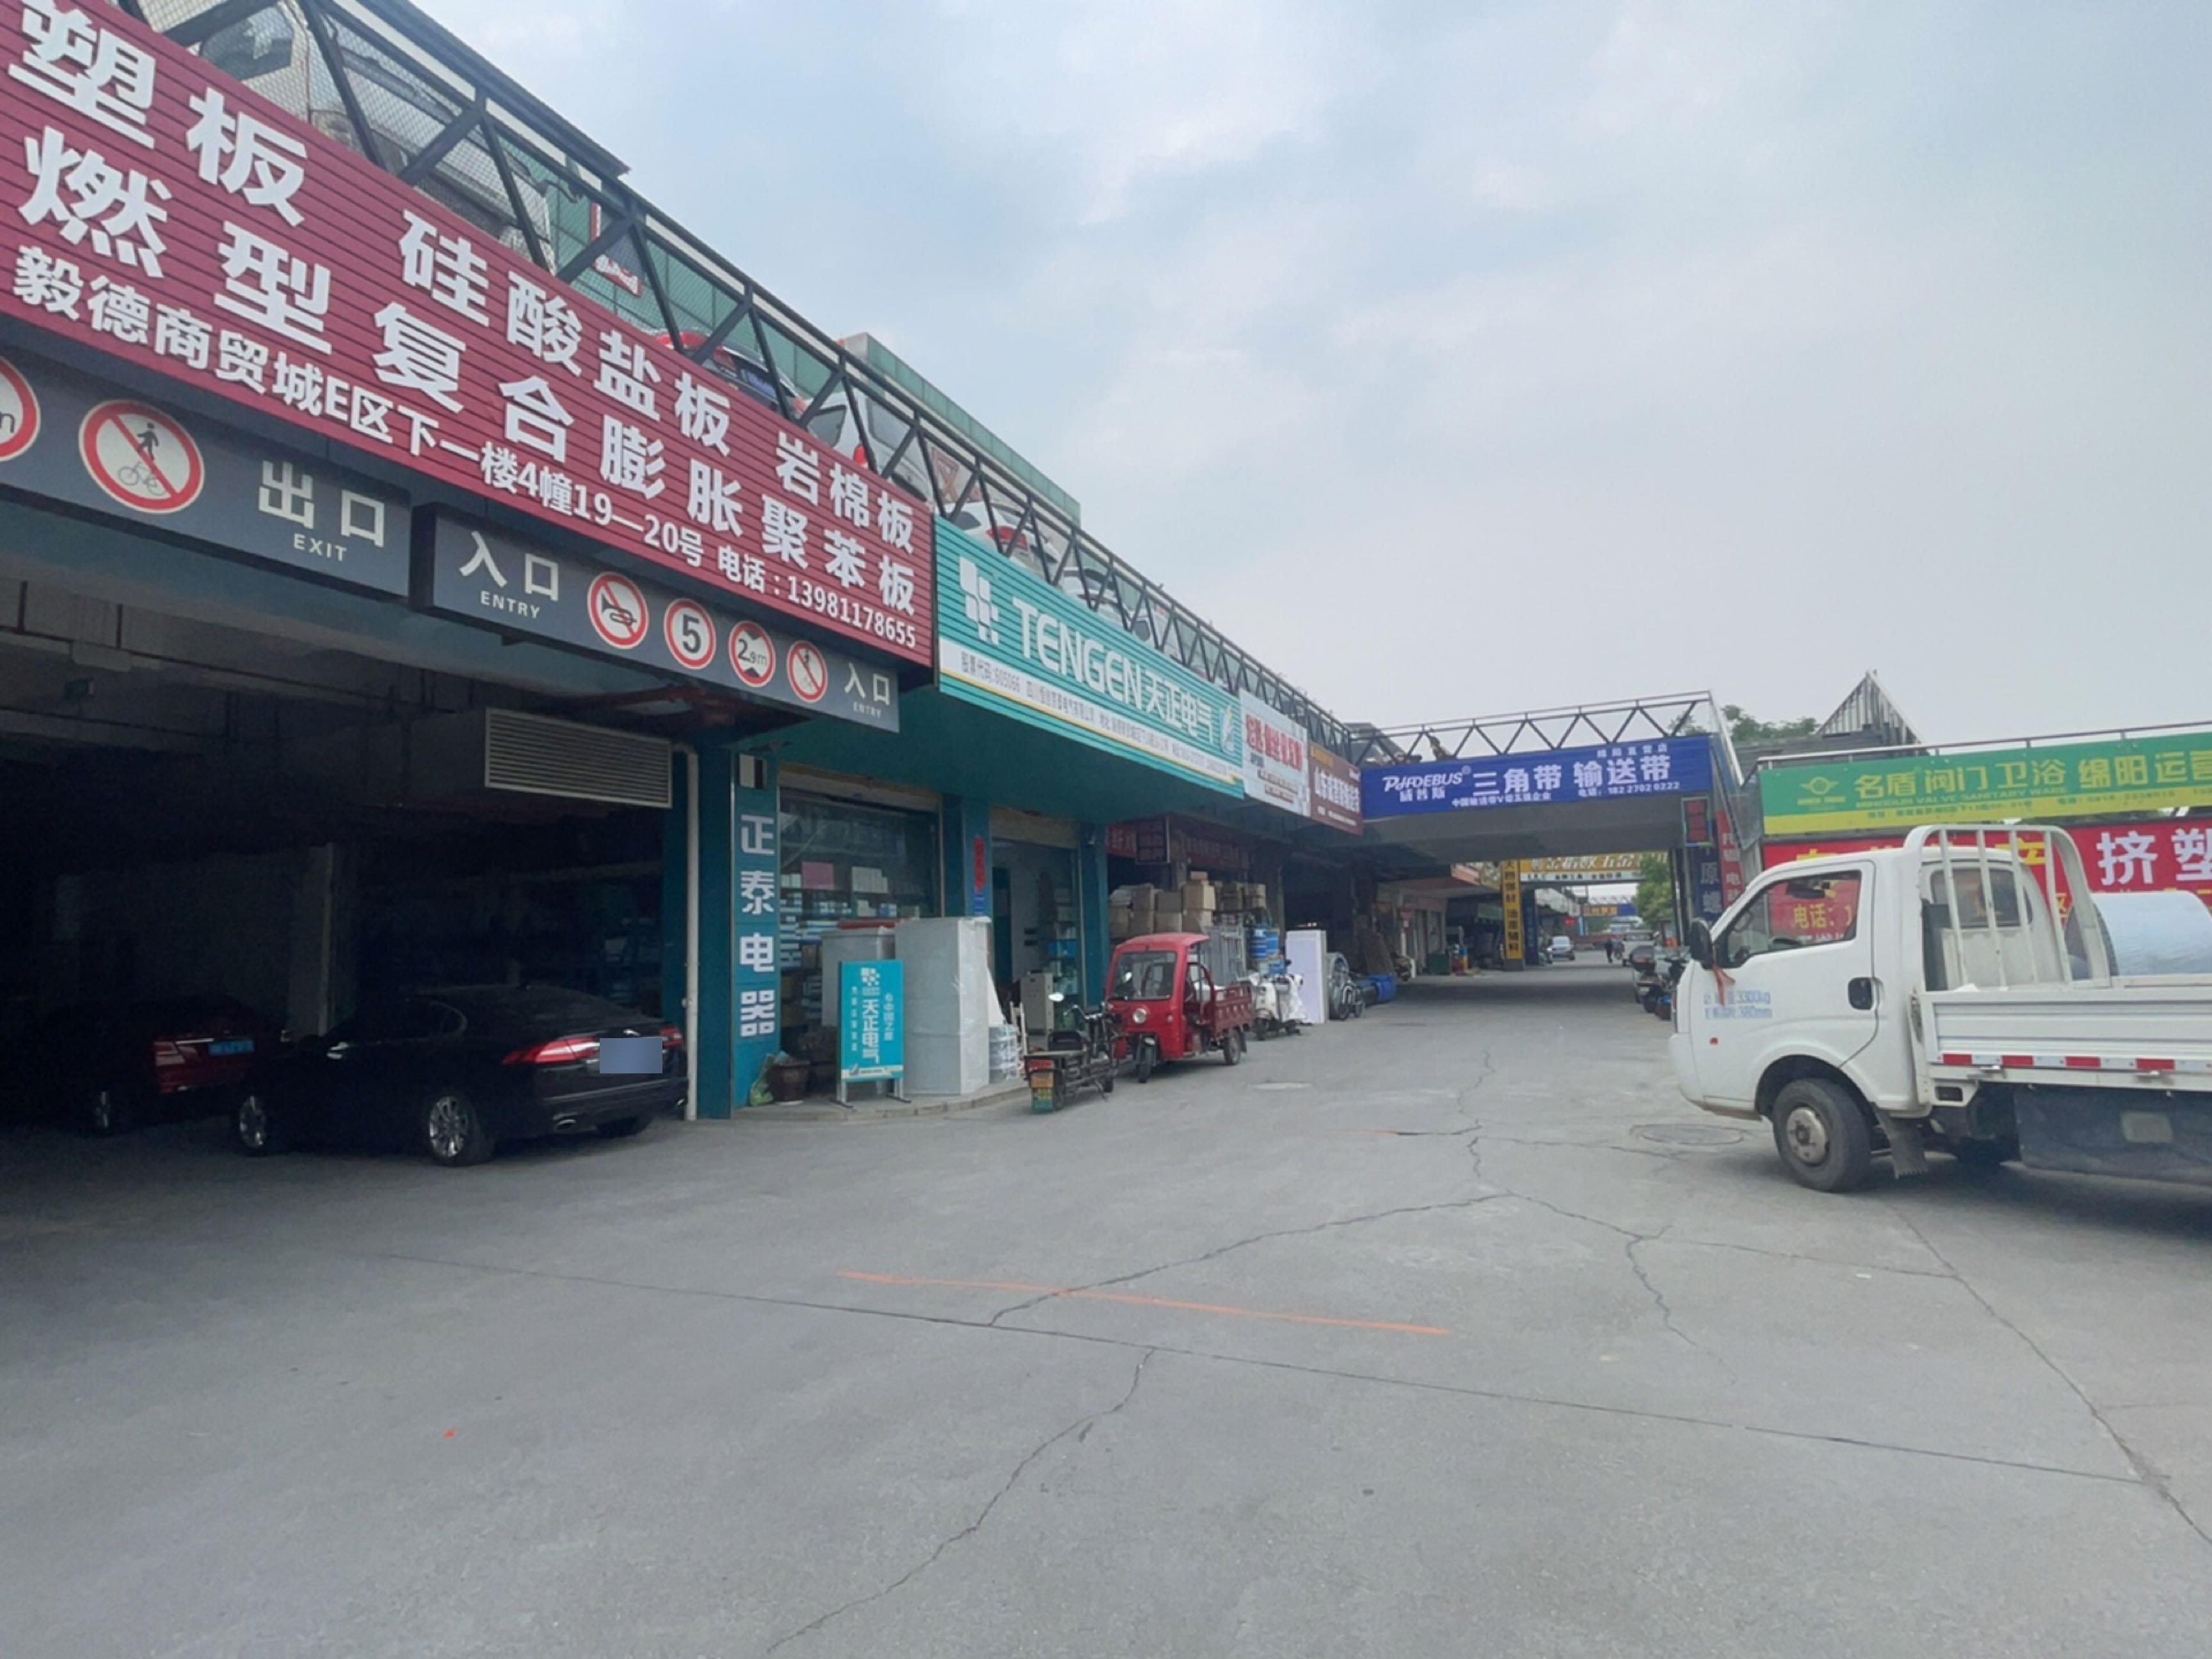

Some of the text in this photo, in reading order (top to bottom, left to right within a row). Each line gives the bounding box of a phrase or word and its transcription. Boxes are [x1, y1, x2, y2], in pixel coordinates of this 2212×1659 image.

[9, 0, 915, 555] 塑板 硅酸盐板 岩棉板
[259, 460, 384, 548] 出口
[294, 533, 348, 562] EXIT
[459, 531, 559, 601] 入口
[480, 590, 541, 619] ENTRY
[682, 614, 701, 654] 5
[1011, 597, 1142, 710] TENGEN
[844, 662, 890, 705] 入口
[853, 701, 882, 718] ENTRY
[1145, 669, 1214, 744] 天正电气
[1473, 754, 1671, 797] 三角带 输送带
[739, 814, 775, 1038] 正泰电器
